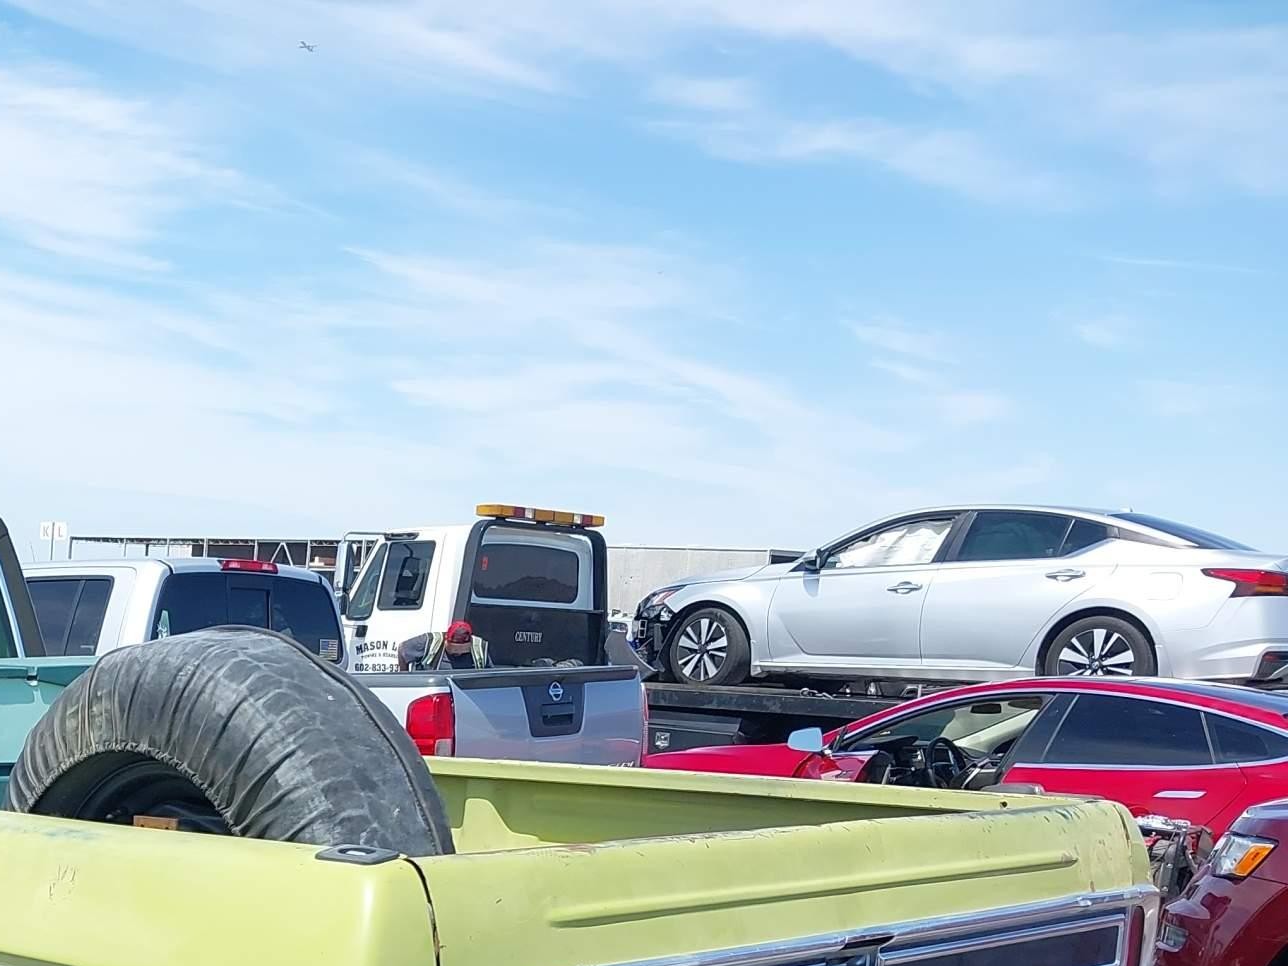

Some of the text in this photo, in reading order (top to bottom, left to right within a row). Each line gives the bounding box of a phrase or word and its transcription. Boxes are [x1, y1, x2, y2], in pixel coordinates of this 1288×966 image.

[43, 525, 50, 537] K
[514, 631, 543, 643] CENTURY
[355, 640, 389, 655] MASON
[354, 663, 399, 672] 602-833-93
